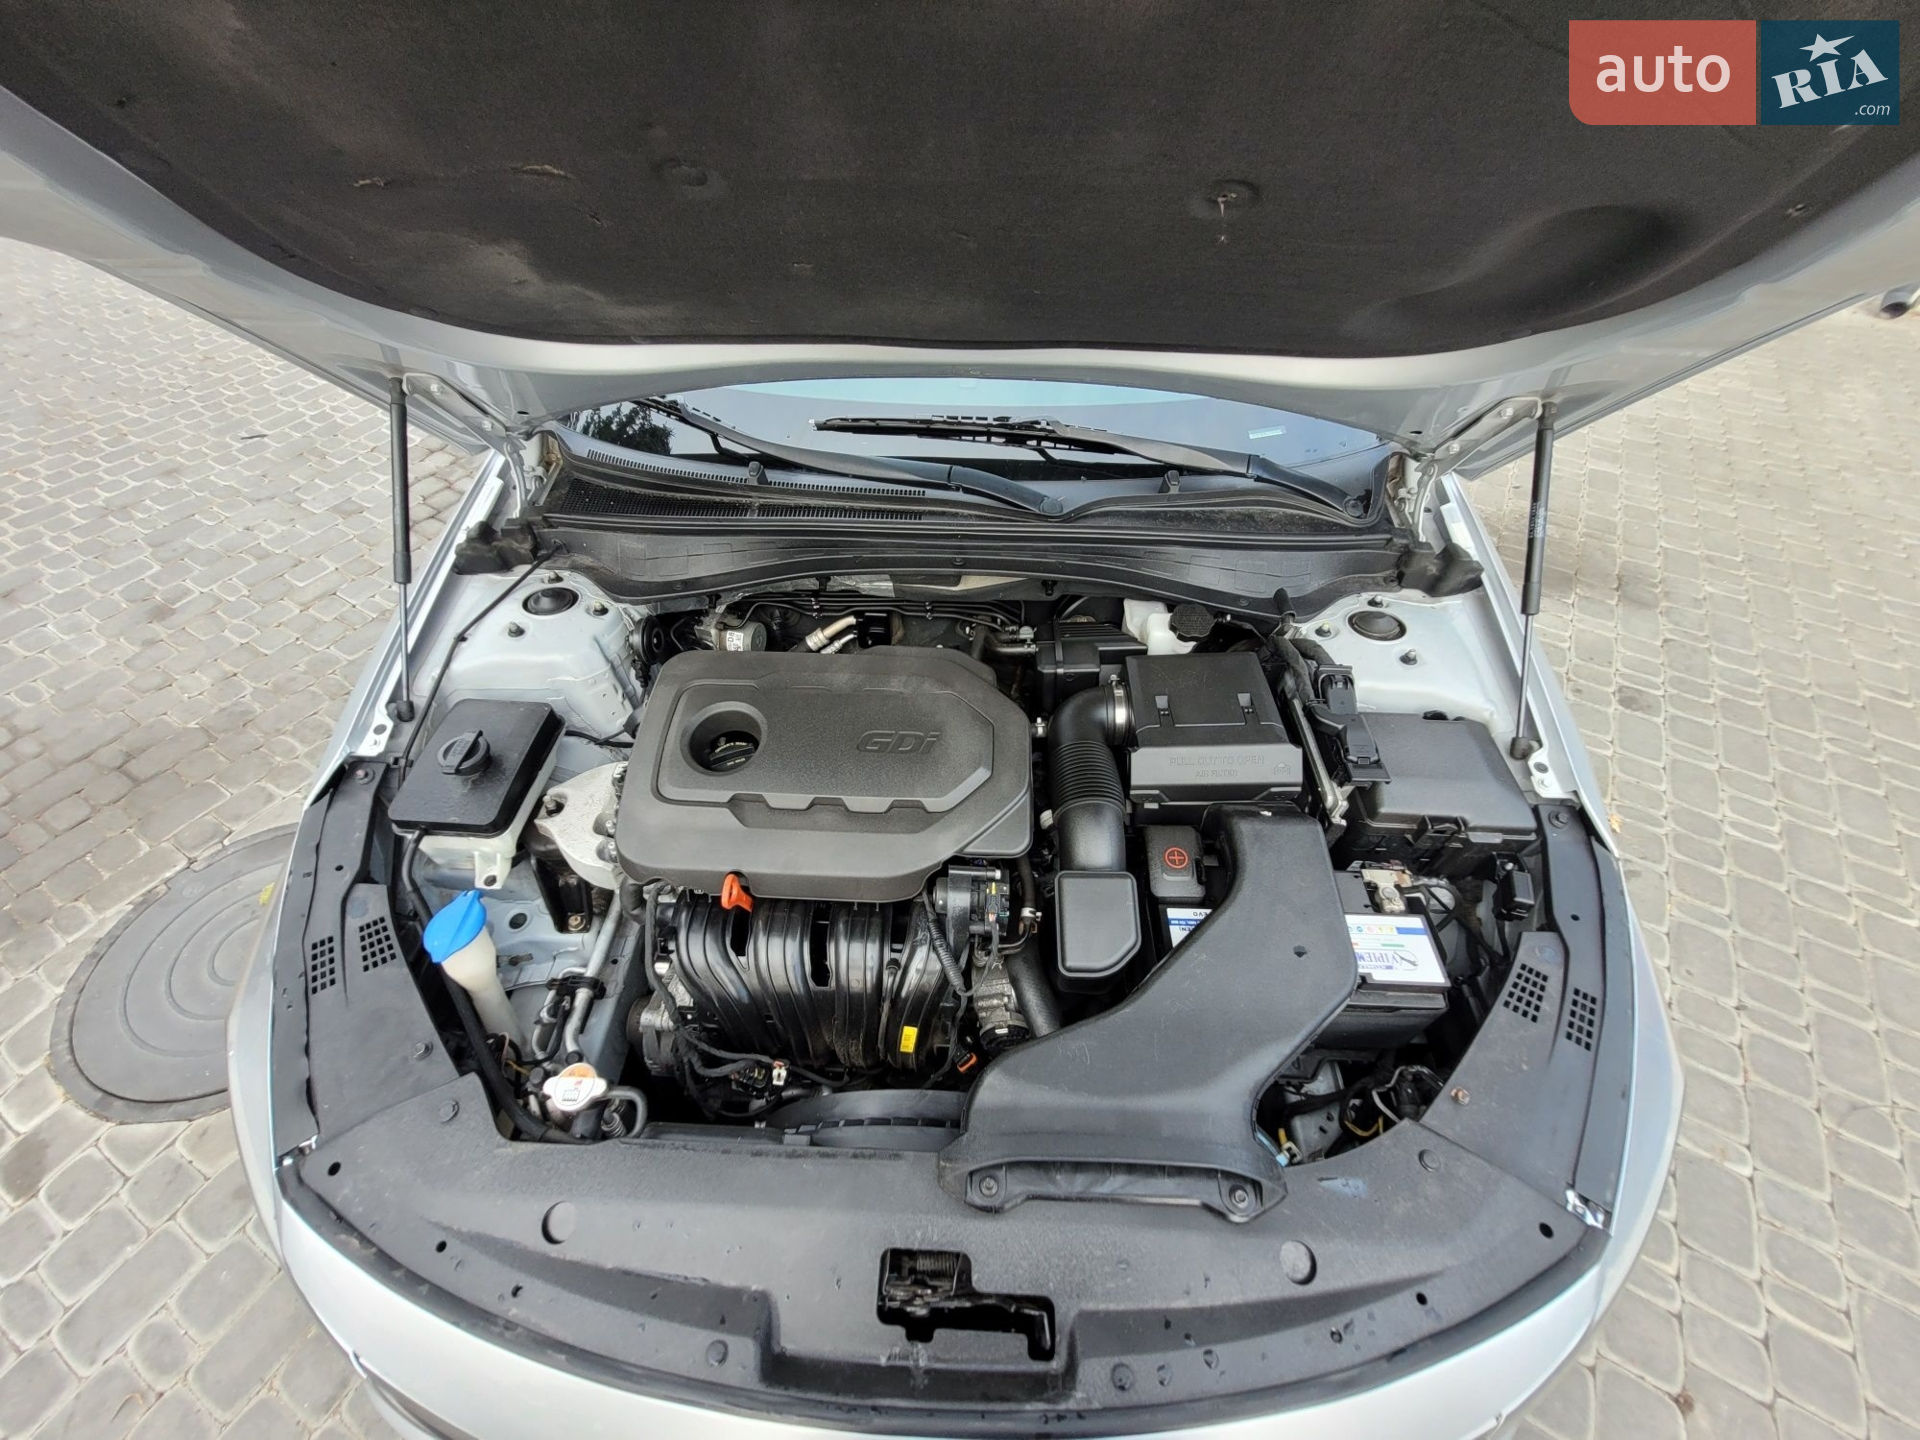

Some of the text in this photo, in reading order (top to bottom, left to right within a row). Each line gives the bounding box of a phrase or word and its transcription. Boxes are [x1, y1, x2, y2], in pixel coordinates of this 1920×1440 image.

[856, 730, 941, 755] GDi
[1169, 756, 1195, 766] PULL
[1197, 756, 1218, 765] OUT
[1236, 755, 1266, 765] OPEN
